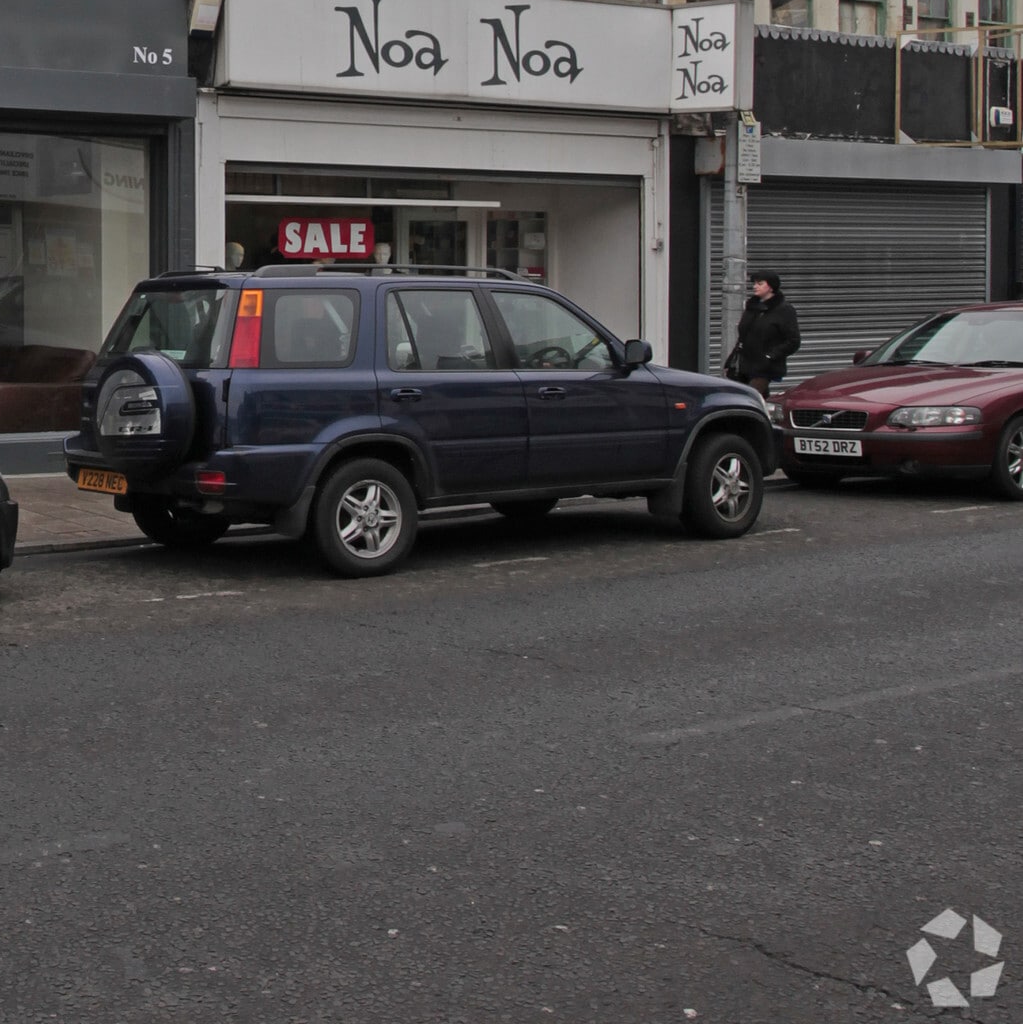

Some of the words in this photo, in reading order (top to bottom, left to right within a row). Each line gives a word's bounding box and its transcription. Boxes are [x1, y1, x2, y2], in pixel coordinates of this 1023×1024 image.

[480, 4, 584, 86] Noa
[677, 17, 731, 58] Noa
[133, 46, 158, 65] No
[162, 48, 173, 65] 5
[676, 61, 729, 100] Noa
[284, 222, 367, 254] SALE
[799, 439, 830, 453] BT52
[832, 441, 858, 454] DRZ
